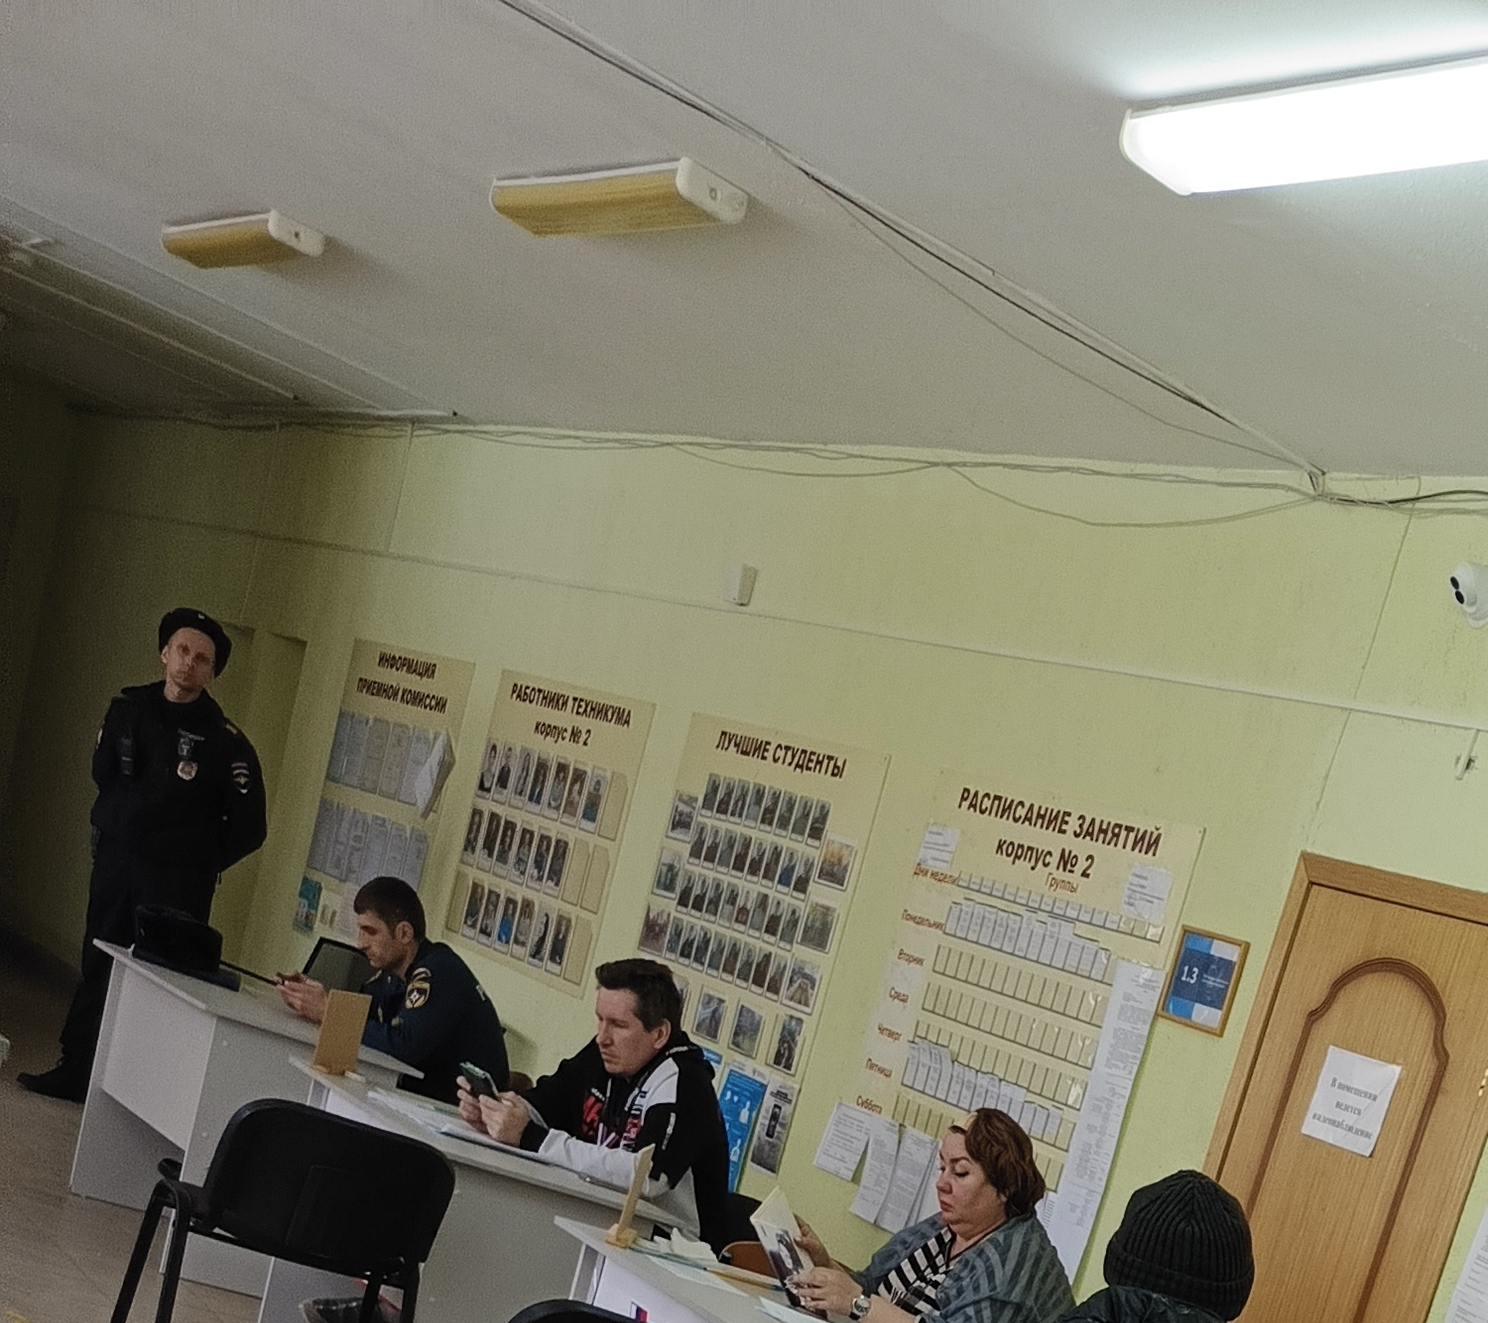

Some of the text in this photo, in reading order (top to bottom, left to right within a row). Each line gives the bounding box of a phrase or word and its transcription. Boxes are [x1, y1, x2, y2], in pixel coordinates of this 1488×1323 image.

[378, 651, 437, 680] ИНФОРМАЦИЯ
[357, 677, 448, 714] ПРИЕМНОЙ КОМИССИИ
[510, 683, 632, 728] РАБОТНИКИ ТЕХНИКУМА
[534, 721, 592, 747] корпус № 2
[715, 730, 847, 779] ЛУЧШИЕ СТУДЕНТЫ
[957, 787, 1162, 857] РАСПИСАНИЕ ЗАНЯТИЙ
[995, 838, 1096, 879] корпус № 2
[1045, 872, 1080, 895] Группы
[896, 948, 925, 968] Вторник
[1181, 965, 1199, 985] 1.3
[888, 986, 910, 1005] Среда
[865, 1057, 893, 1080] Пятница
[856, 1094, 883, 1116] Суббота
